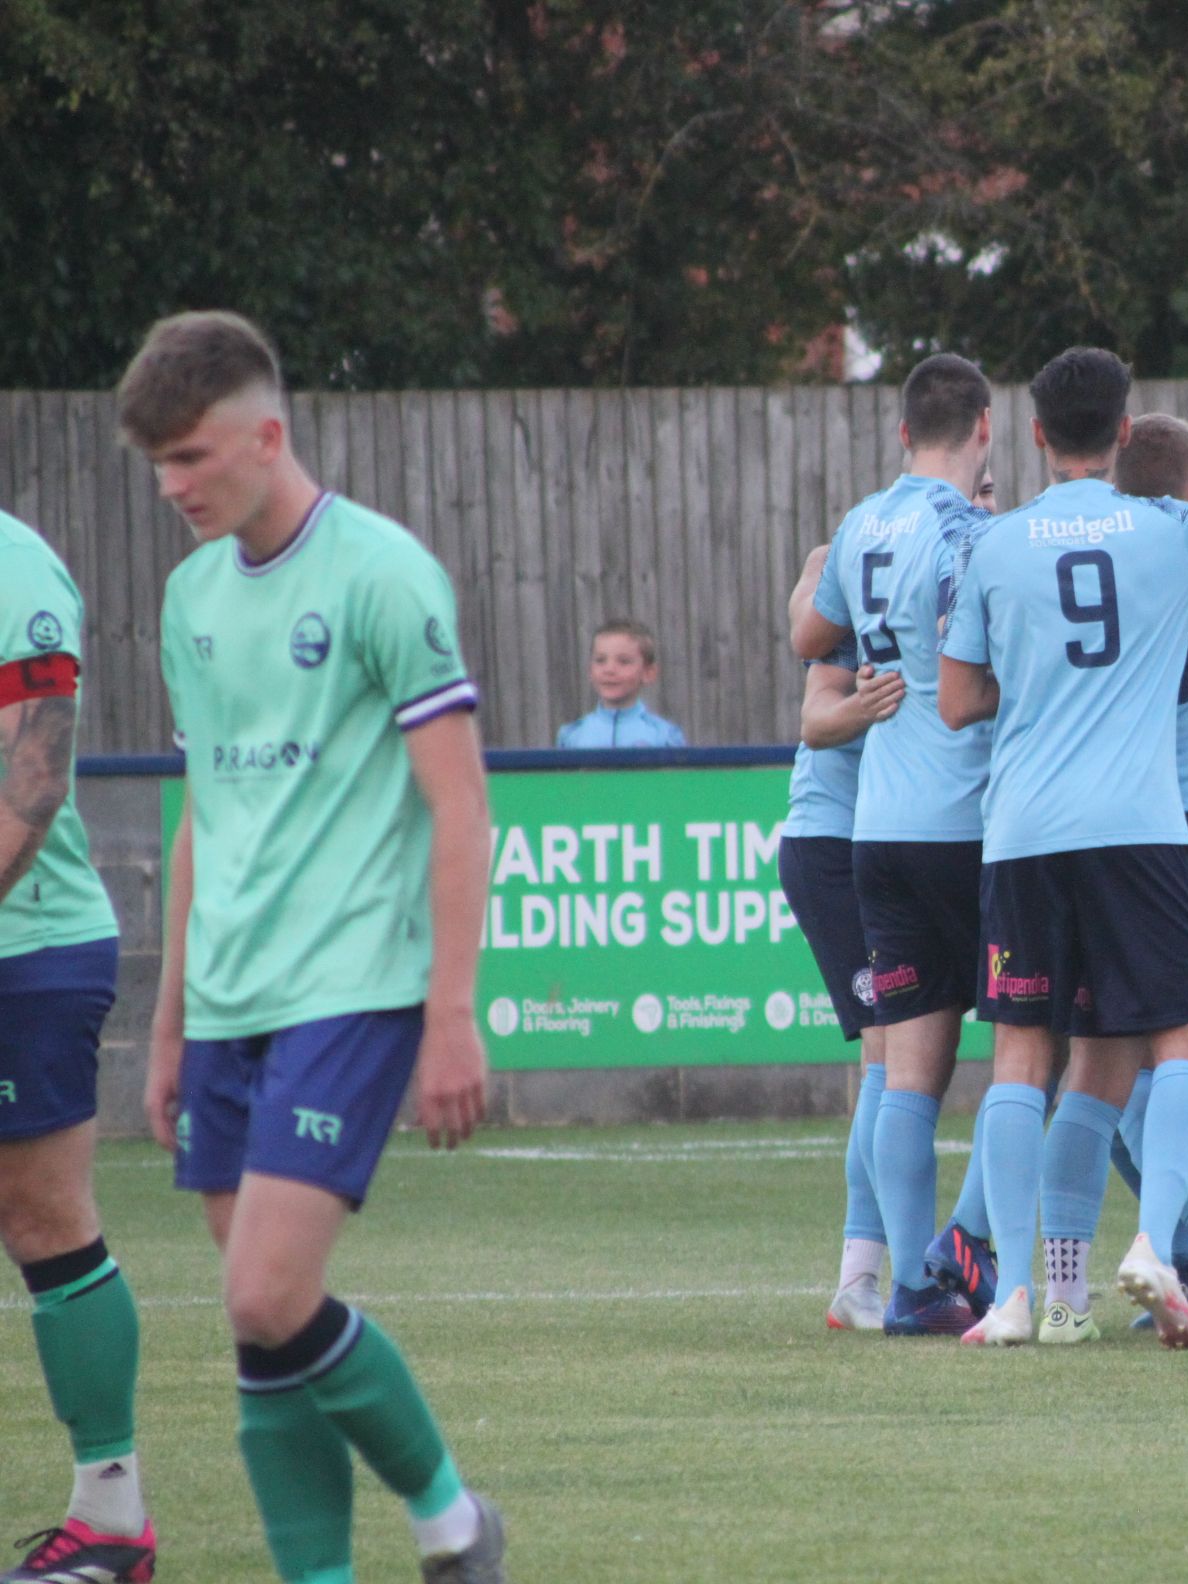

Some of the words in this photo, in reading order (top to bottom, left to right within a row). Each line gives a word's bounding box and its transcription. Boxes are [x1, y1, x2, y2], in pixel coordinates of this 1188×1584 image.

[1027, 510, 1136, 544] Hudgell
[860, 551, 902, 664] 5
[1056, 550, 1120, 669] 9
[660, 889, 806, 947] SUPP
